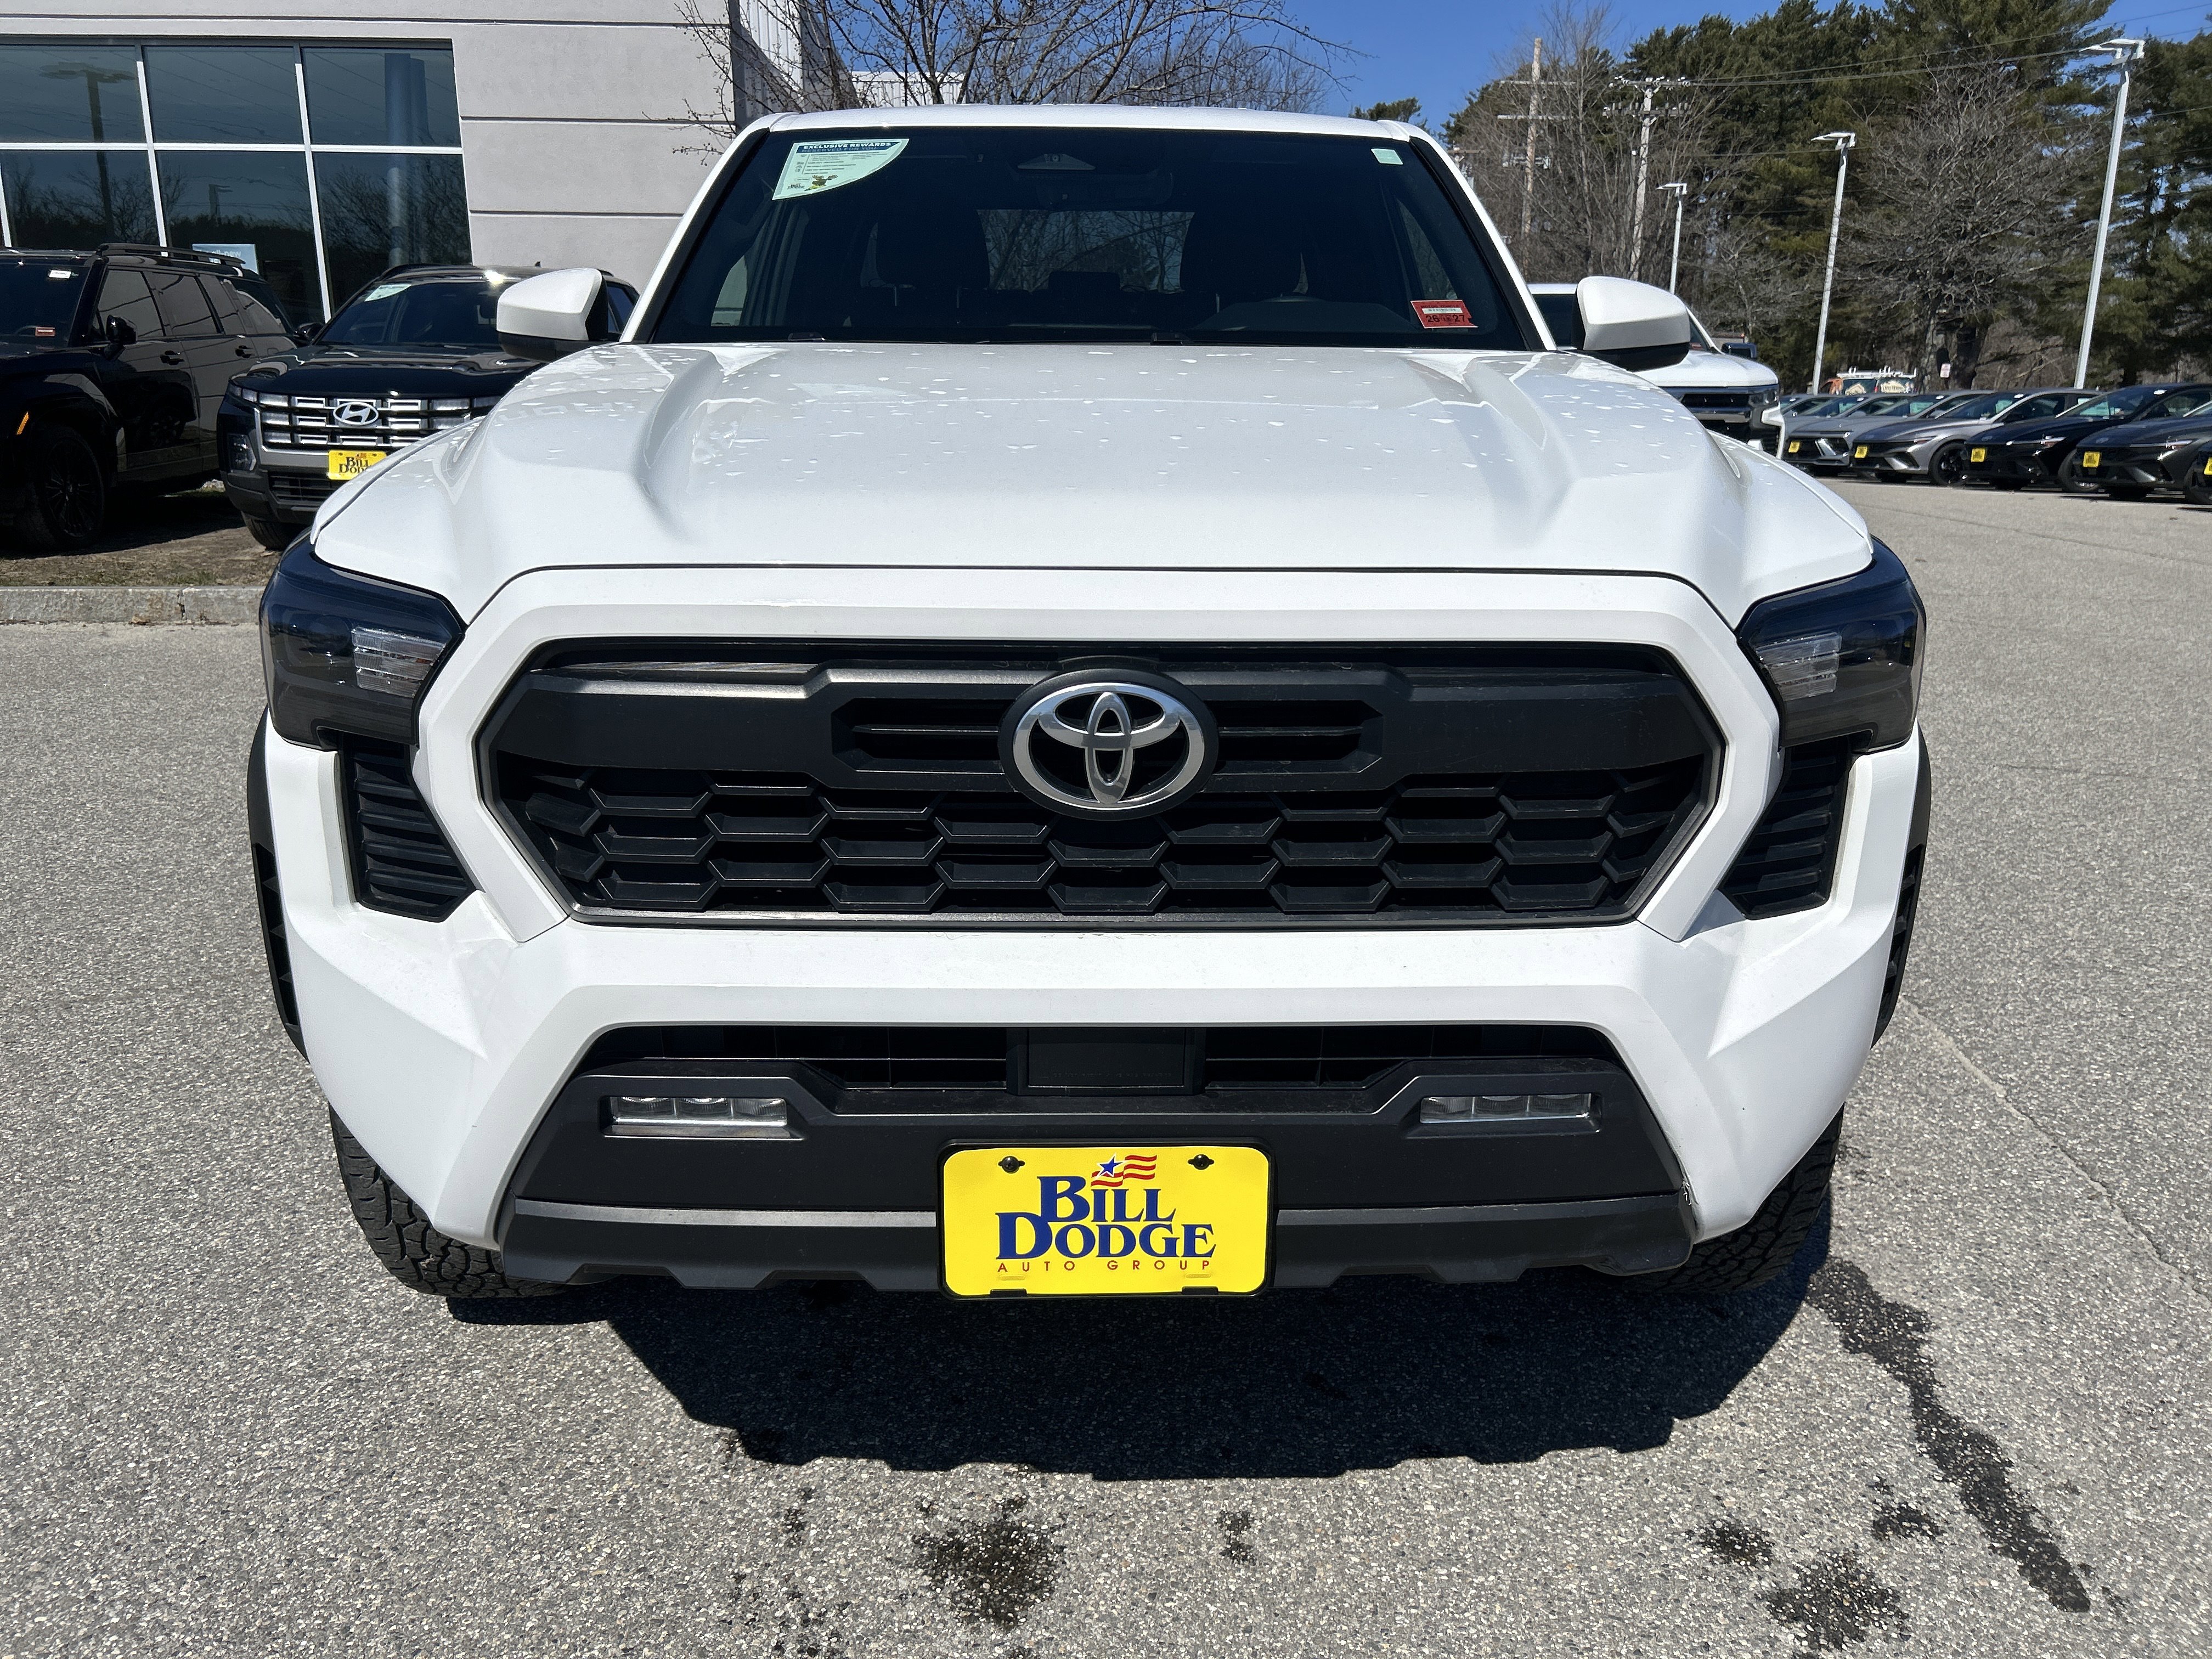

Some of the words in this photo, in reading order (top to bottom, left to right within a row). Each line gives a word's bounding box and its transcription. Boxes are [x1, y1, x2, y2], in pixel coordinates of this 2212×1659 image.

[1452, 314, 1465, 323] 27
[346, 456, 370, 467] BILL
[1036, 1176, 1177, 1222] BILL
[995, 1211, 1217, 1260] DODGE
[997, 1261, 1075, 1272] AUTO
[1107, 1260, 1210, 1271] GROUP
